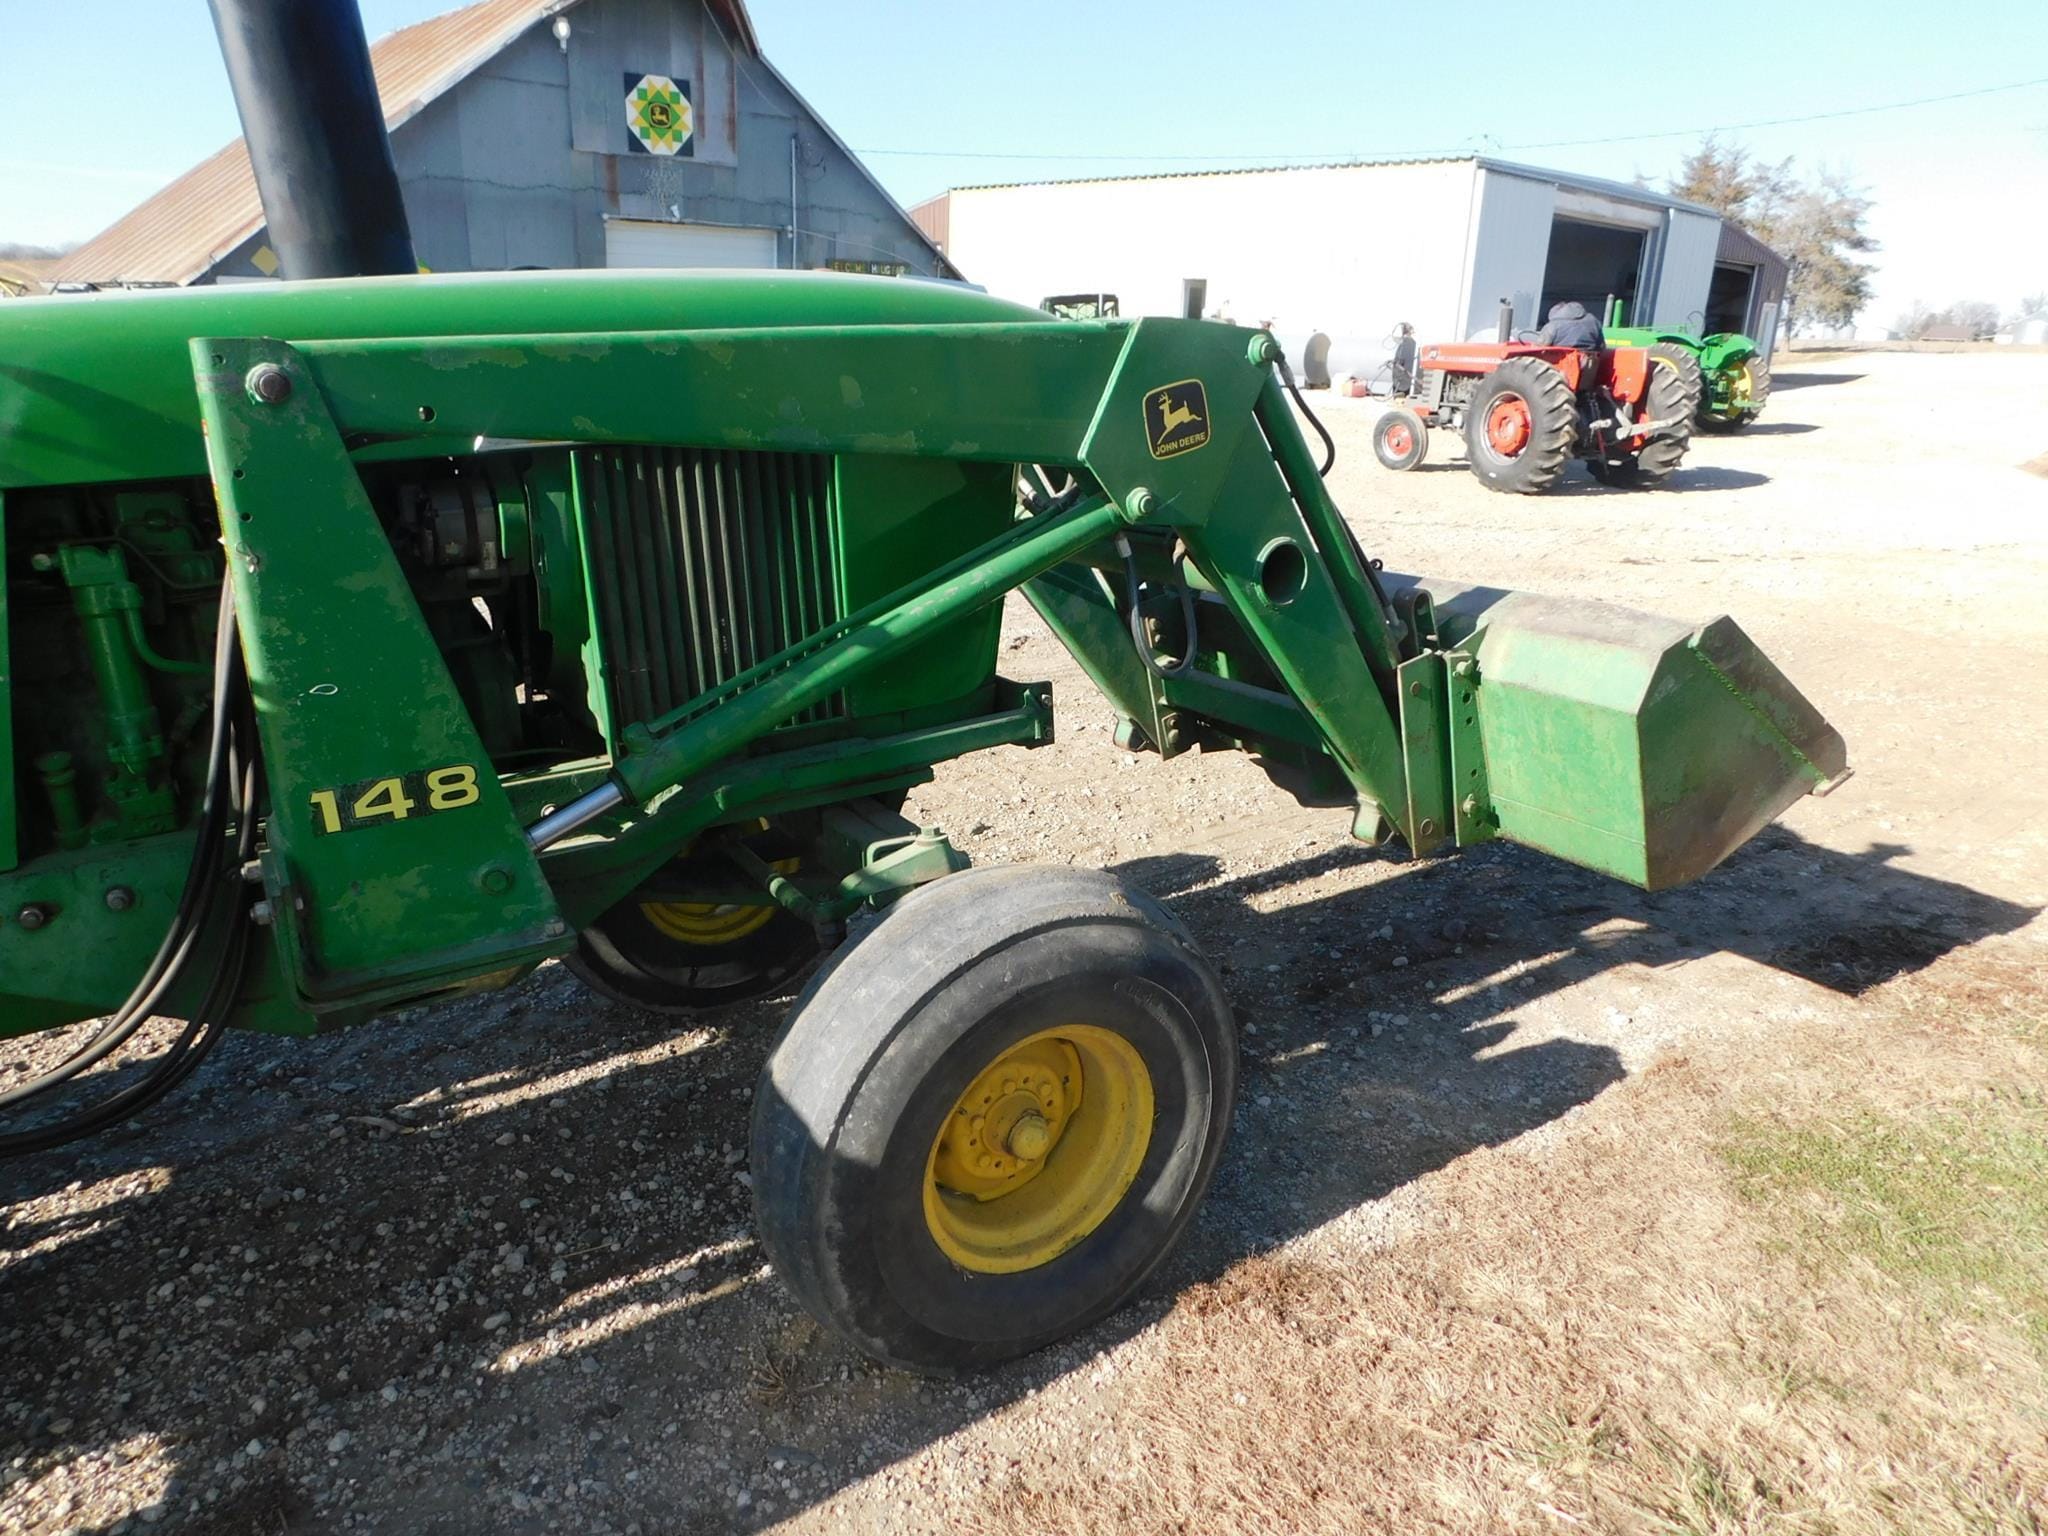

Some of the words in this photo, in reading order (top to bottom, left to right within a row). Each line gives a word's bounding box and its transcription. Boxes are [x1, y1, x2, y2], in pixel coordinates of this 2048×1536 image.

[1155, 441, 1178, 455] JOHN
[1179, 432, 1206, 447] DEERE
[310, 764, 480, 833] 148
